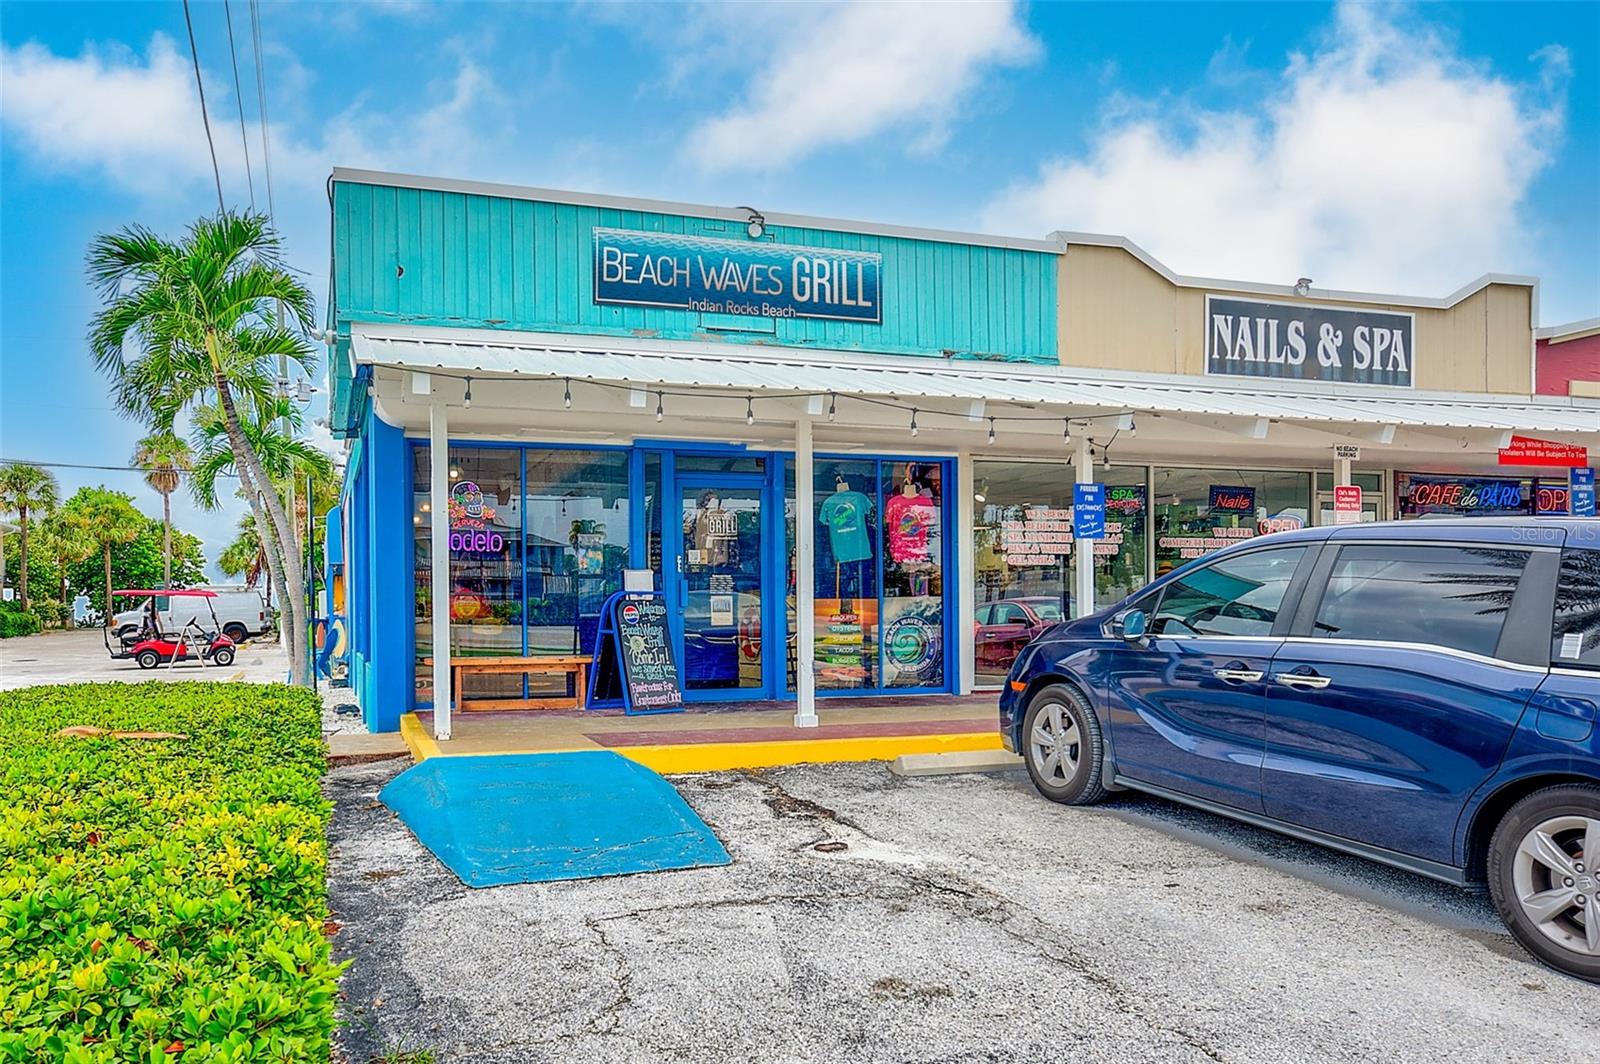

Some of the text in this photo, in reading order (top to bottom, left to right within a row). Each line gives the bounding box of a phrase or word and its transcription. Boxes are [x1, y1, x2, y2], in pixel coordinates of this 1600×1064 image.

[602, 247, 872, 307] BEACH WAVES GRILL
[688, 297, 796, 318] Indian Rocks Beach
[1212, 314, 1408, 372] NAILS & SPA
[1546, 450, 1567, 458] Subject
[1111, 489, 1134, 500] SPA
[1215, 494, 1250, 509] Nails
[1416, 482, 1522, 507] CAFE de PARIS
[1538, 489, 1569, 511] OP
[709, 519, 737, 534] GRILL
[448, 528, 504, 553] odelo
